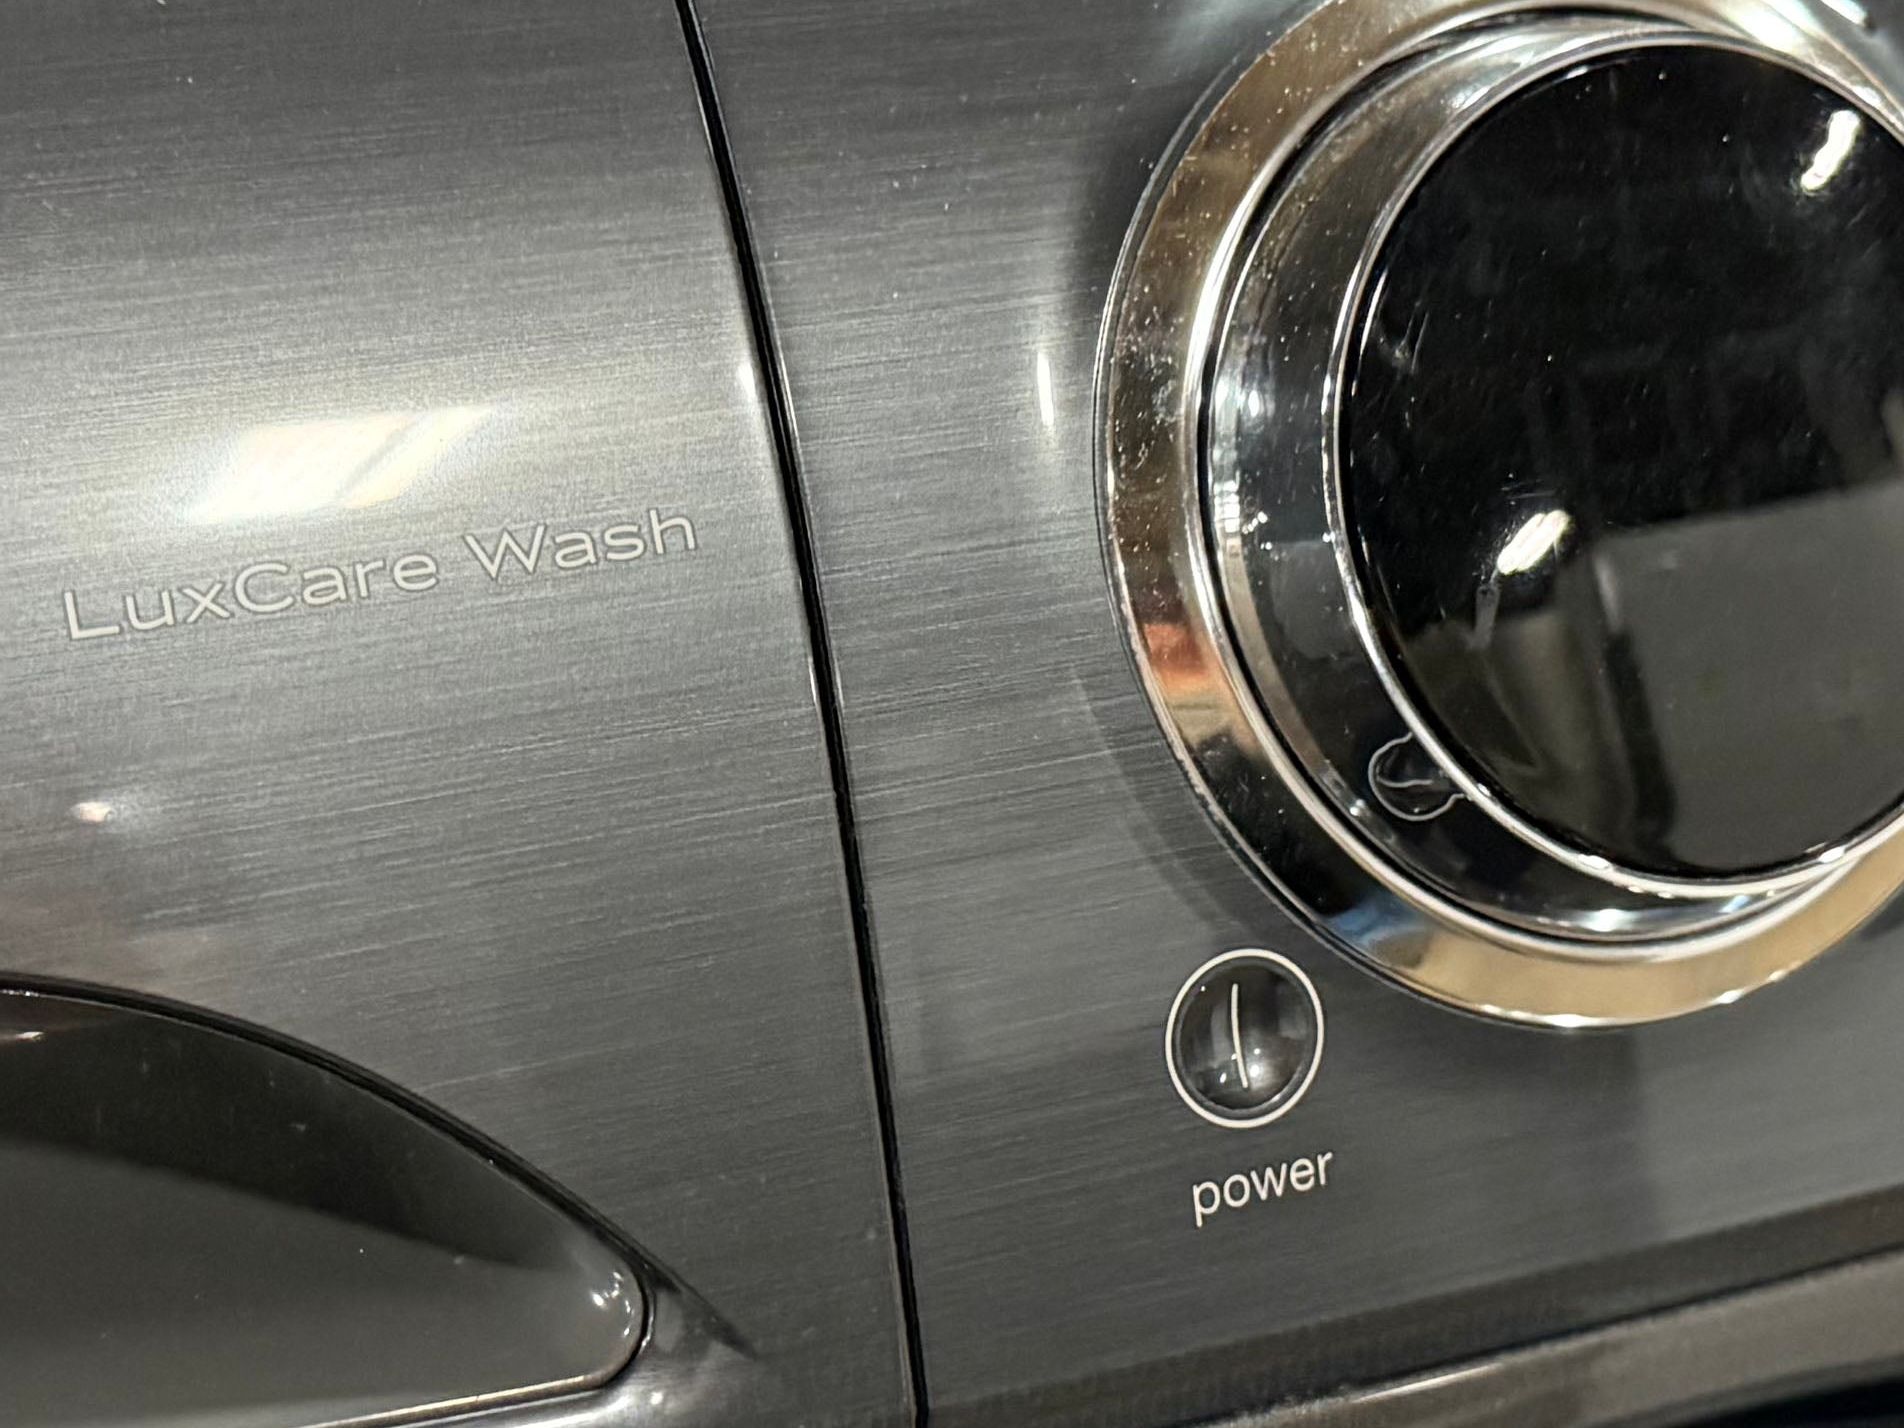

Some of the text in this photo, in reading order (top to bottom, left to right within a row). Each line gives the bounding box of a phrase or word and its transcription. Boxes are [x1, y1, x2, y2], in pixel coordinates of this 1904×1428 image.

[63, 507, 697, 641] LuxCare Wash
[1192, 1149, 1334, 1228] power
